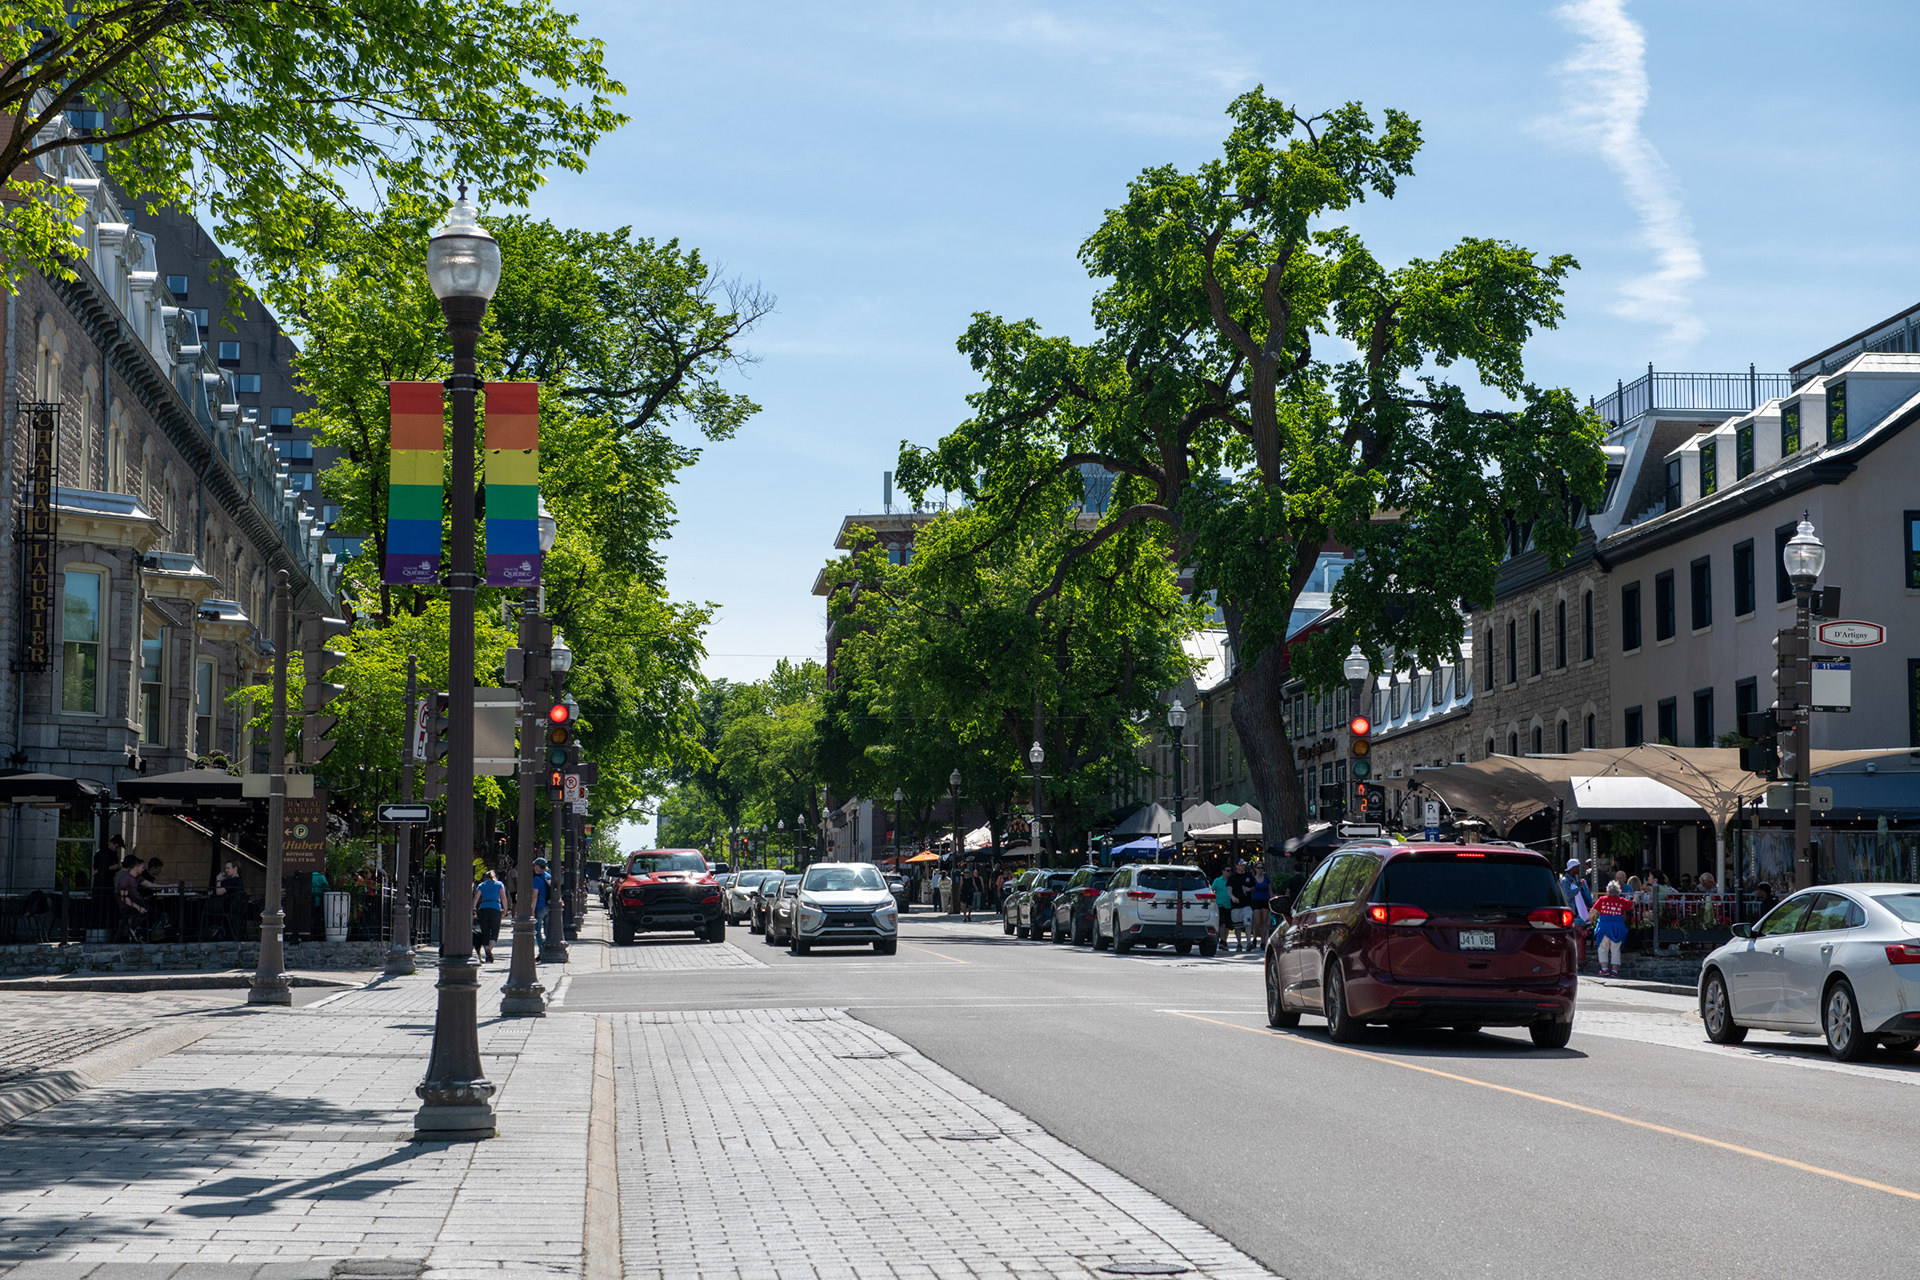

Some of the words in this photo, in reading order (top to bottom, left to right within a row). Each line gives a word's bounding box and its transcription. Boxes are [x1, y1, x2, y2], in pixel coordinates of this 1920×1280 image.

[34, 412, 51, 531] CHÂTEAU
[30, 543, 48, 664] LAURIER
[1834, 631, 1868, 640] D'Artigny
[282, 840, 324, 850] tHubert
[1460, 935, 1475, 945] J41
